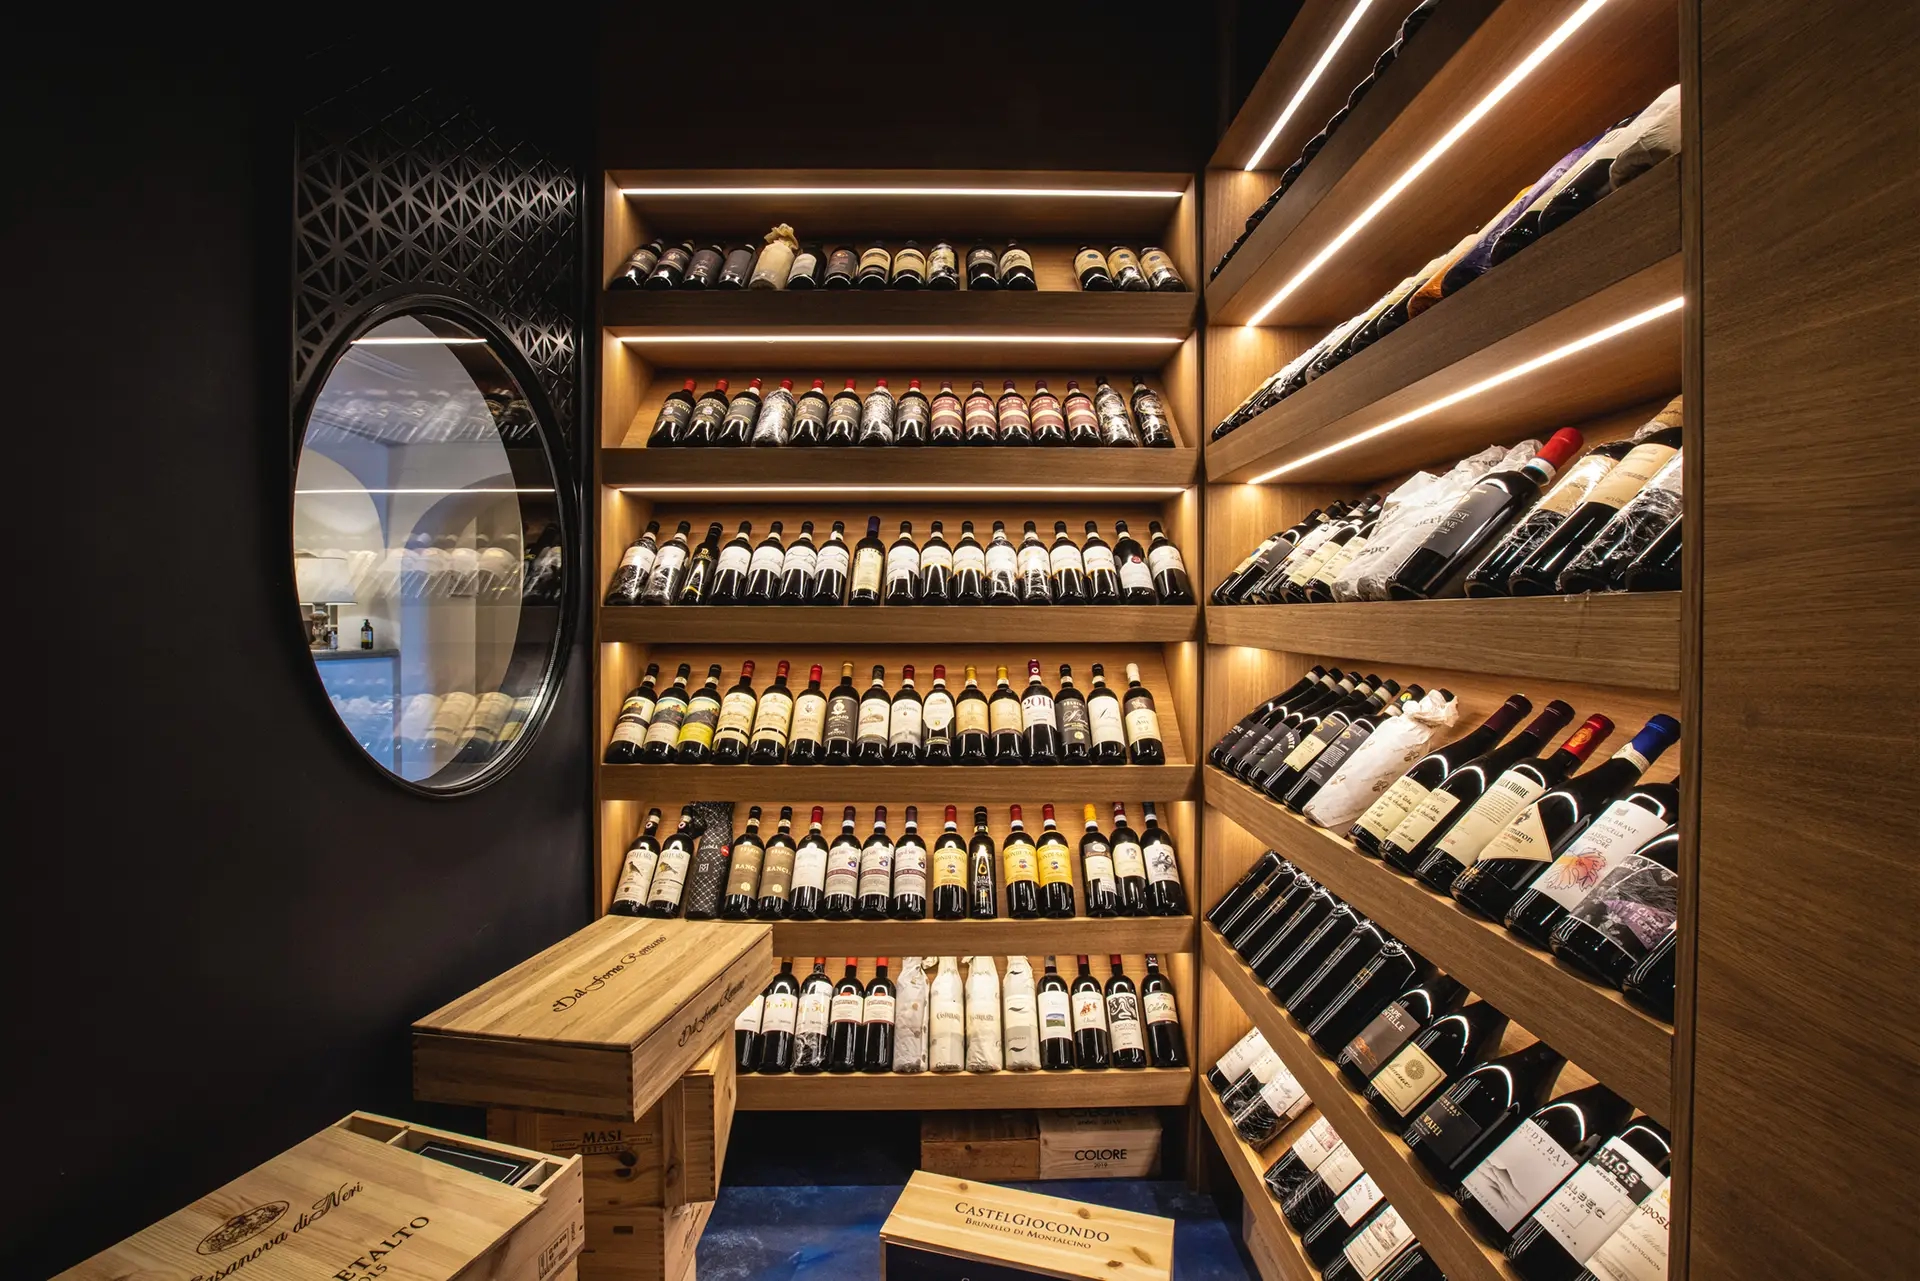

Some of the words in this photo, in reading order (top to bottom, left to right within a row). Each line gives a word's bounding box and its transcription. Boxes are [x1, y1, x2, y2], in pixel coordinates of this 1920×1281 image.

[1386, 1004, 1402, 1019] CAPE
[582, 1130, 622, 1144] MASI
[1075, 1149, 1127, 1161] COLORE
[1545, 1145, 1570, 1169] BAY
[293, 1213, 312, 1234] di
[309, 1181, 364, 1222] Neri
[1563, 1180, 1608, 1219] ALBEC
